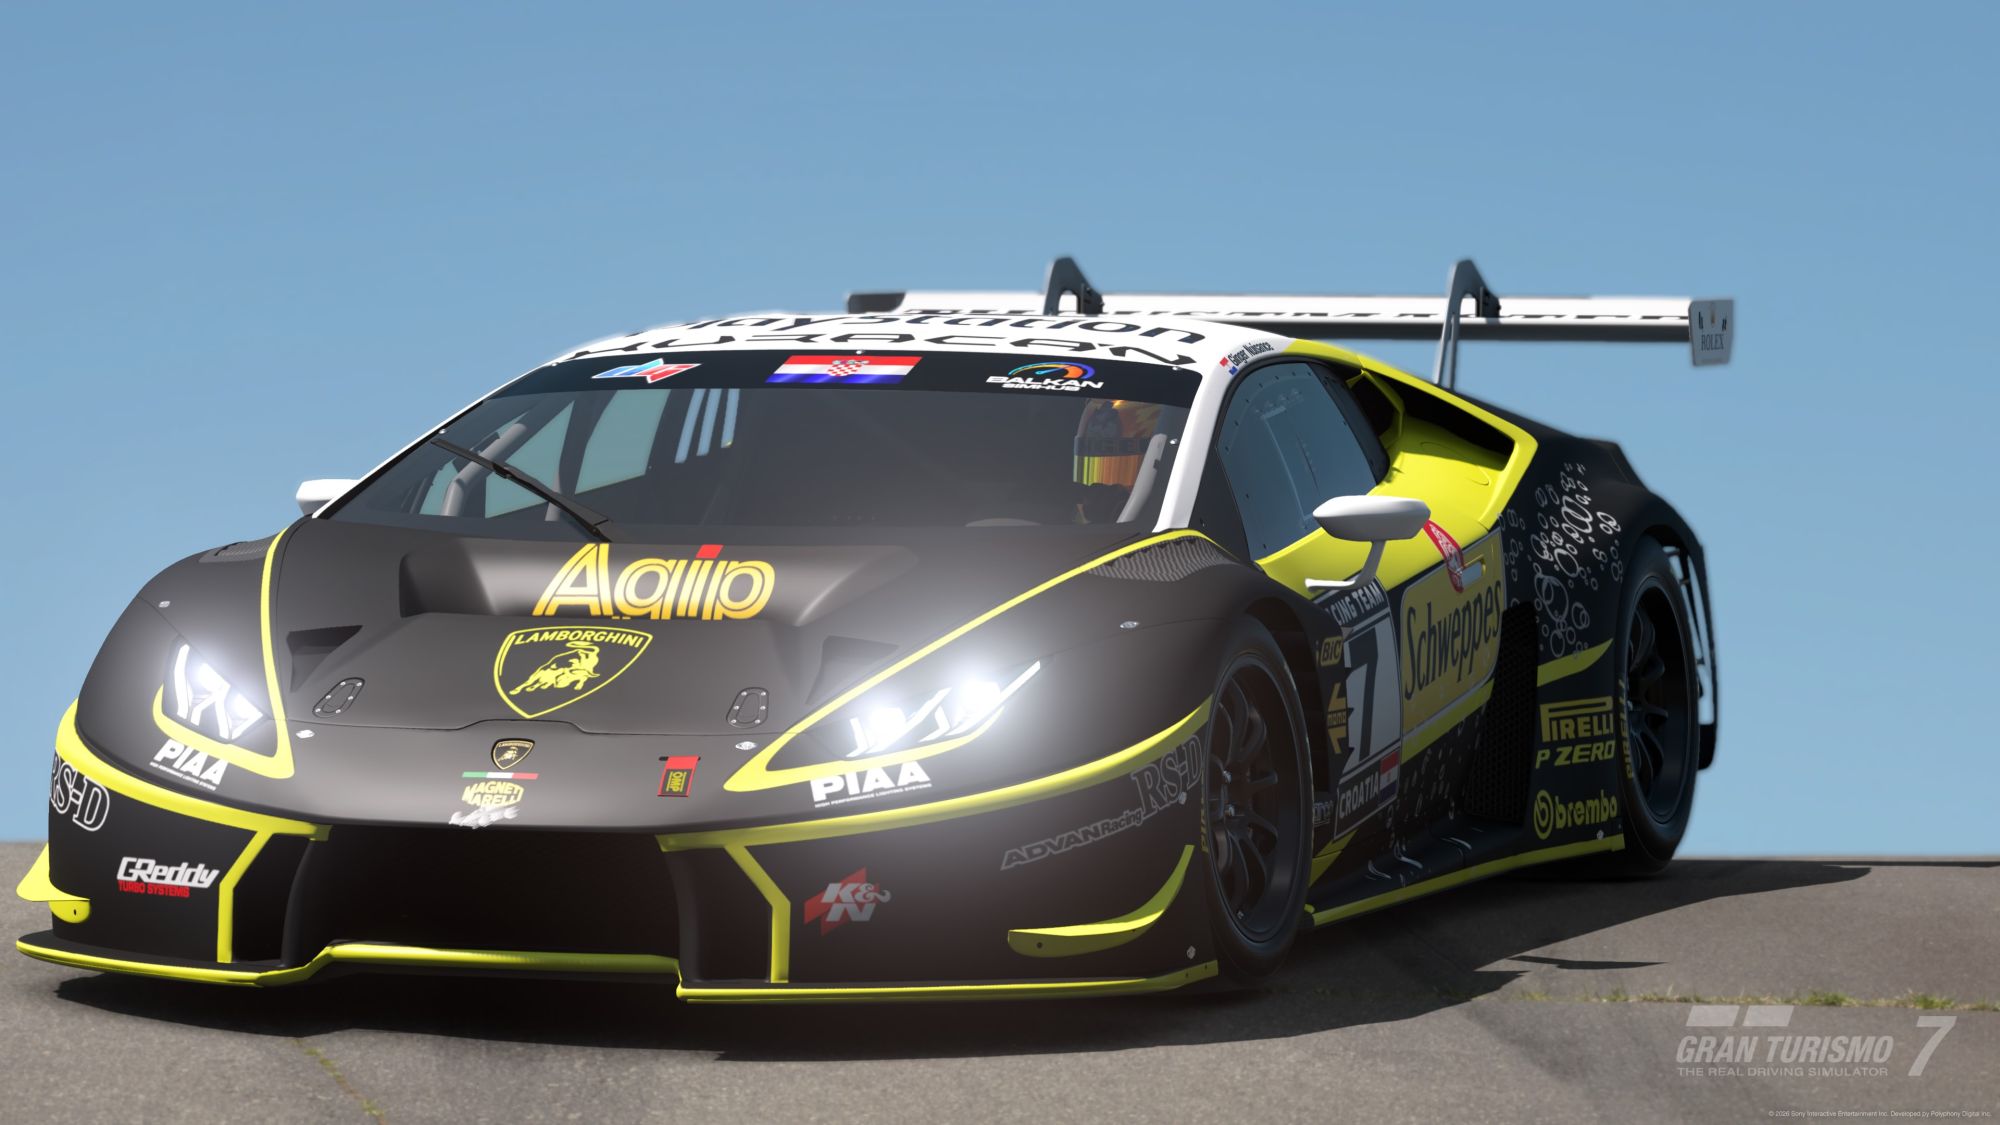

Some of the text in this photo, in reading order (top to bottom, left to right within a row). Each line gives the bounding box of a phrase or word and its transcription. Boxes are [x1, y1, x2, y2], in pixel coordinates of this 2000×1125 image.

[1700, 333, 1725, 352] ROLEX
[986, 375, 1104, 389] BALKAN
[1001, 383, 1081, 392] SIMHUB
[1326, 581, 1383, 627] CING TEAM
[514, 629, 644, 649] LAMBORGHINI
[1404, 580, 1501, 701] Schweppes
[1539, 696, 1615, 743] PIRELLI
[153, 738, 229, 786] PIAA
[1535, 740, 1616, 769] P ZERO
[810, 760, 931, 803] PIAA
[1339, 771, 1380, 820] CROATIA
[1555, 788, 1618, 830] brembo
[1001, 808, 1143, 871] ADVAN Racing
[116, 856, 221, 889] GReddy
[118, 880, 191, 898] TURBO SYSTEMS
